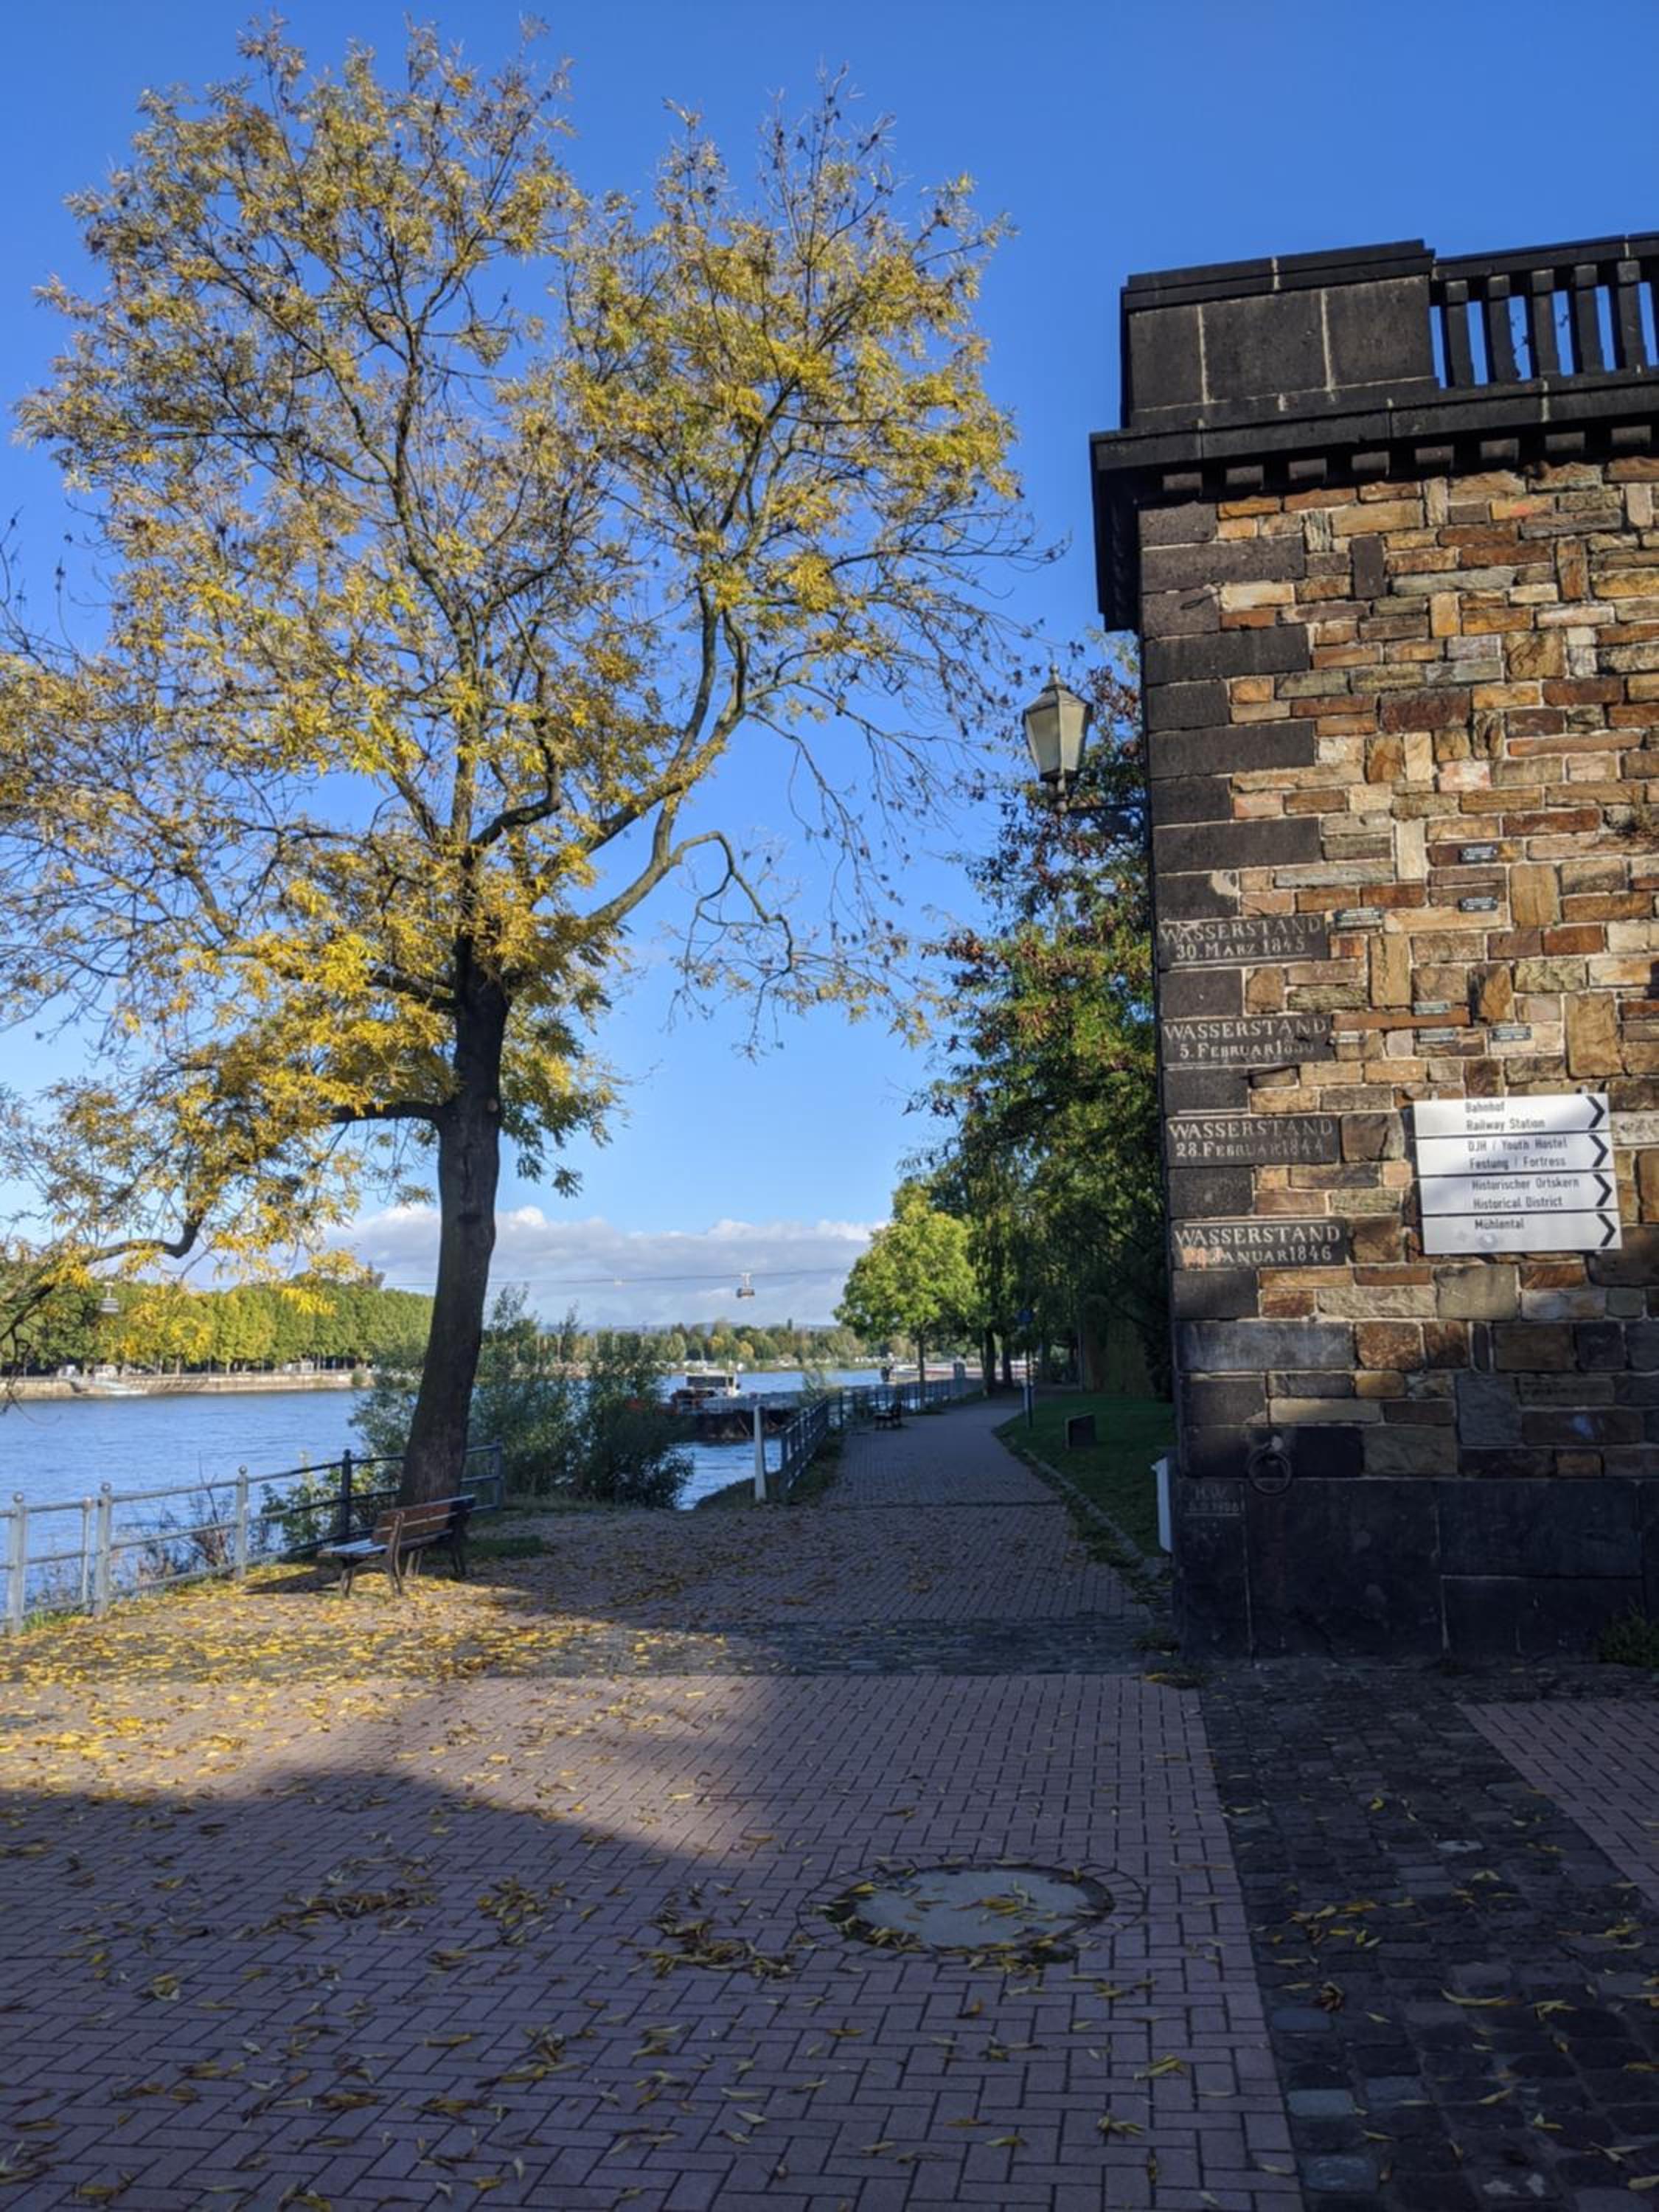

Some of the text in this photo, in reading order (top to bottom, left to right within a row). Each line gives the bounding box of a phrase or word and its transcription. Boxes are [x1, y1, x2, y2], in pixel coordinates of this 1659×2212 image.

[1160, 917, 1321, 945] WASSERSTAND
[1164, 1018, 1327, 1040] WASSERSTAND
[1465, 1102, 1505, 1113] Bahnhof
[1169, 1119, 1332, 1139] WASSERSTAND
[1466, 1118, 1545, 1131] Railway Station
[1468, 1141, 1487, 1152] DJH
[1502, 1139, 1530, 1150] Youth
[1534, 1138, 1568, 1149] Hostel
[1470, 1158, 1509, 1170] Festung
[1523, 1156, 1567, 1167] Fortress
[1472, 1177, 1579, 1190] Historischer Ortskern
[1473, 1197, 1562, 1209] Historical District
[1175, 1226, 1340, 1246] WASSERSTAND
